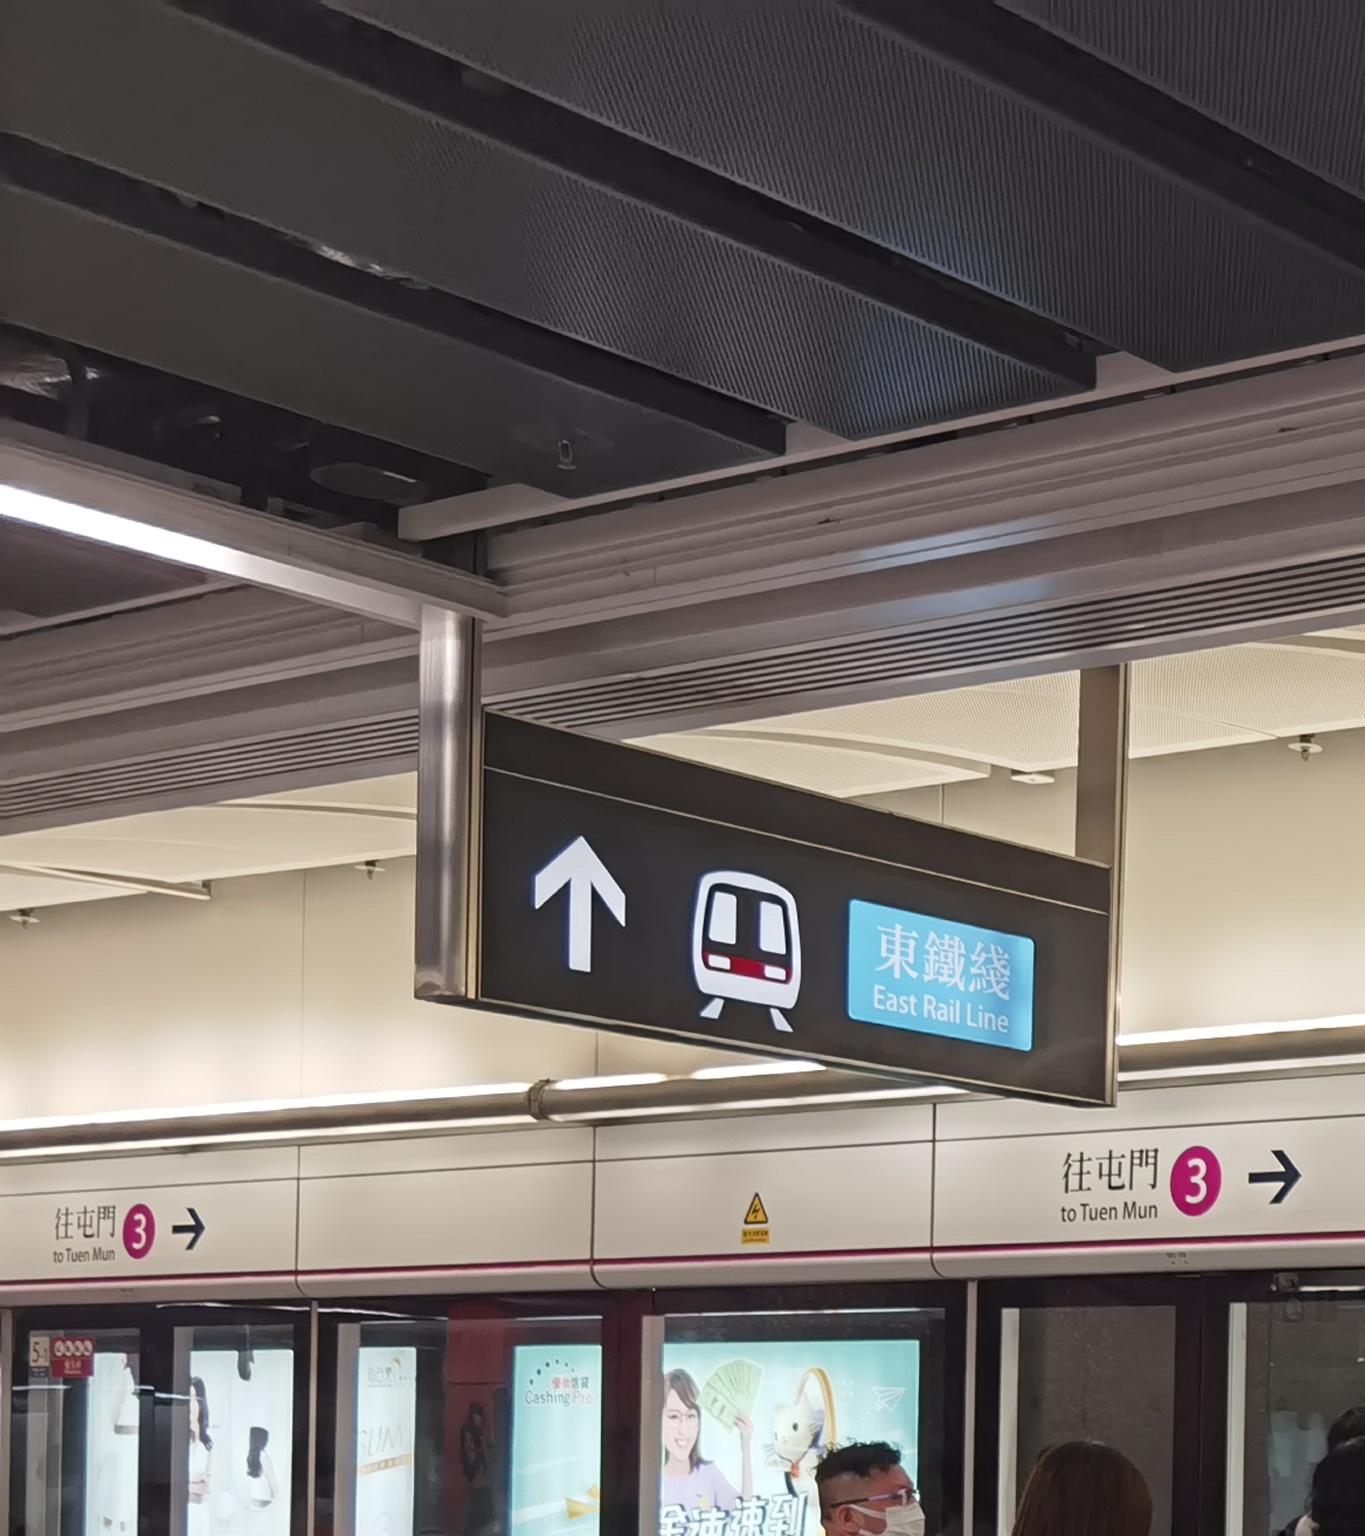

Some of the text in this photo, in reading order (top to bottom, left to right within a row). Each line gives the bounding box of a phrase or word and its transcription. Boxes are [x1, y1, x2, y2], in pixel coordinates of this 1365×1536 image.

[875, 923, 1010, 1000] 東鐵綫
[873, 984, 1009, 1033] East Rail Line
[1062, 1147, 1159, 1194] 往屯門
[1185, 1157, 1208, 1205] 3
[54, 1205, 116, 1240] 往屯門
[1061, 1201, 1158, 1222] to Tuen Mun
[132, 1213, 147, 1250] 3
[53, 1247, 115, 1263] to Tuen Mun
[525, 1390, 594, 1407] Cashing Pro
